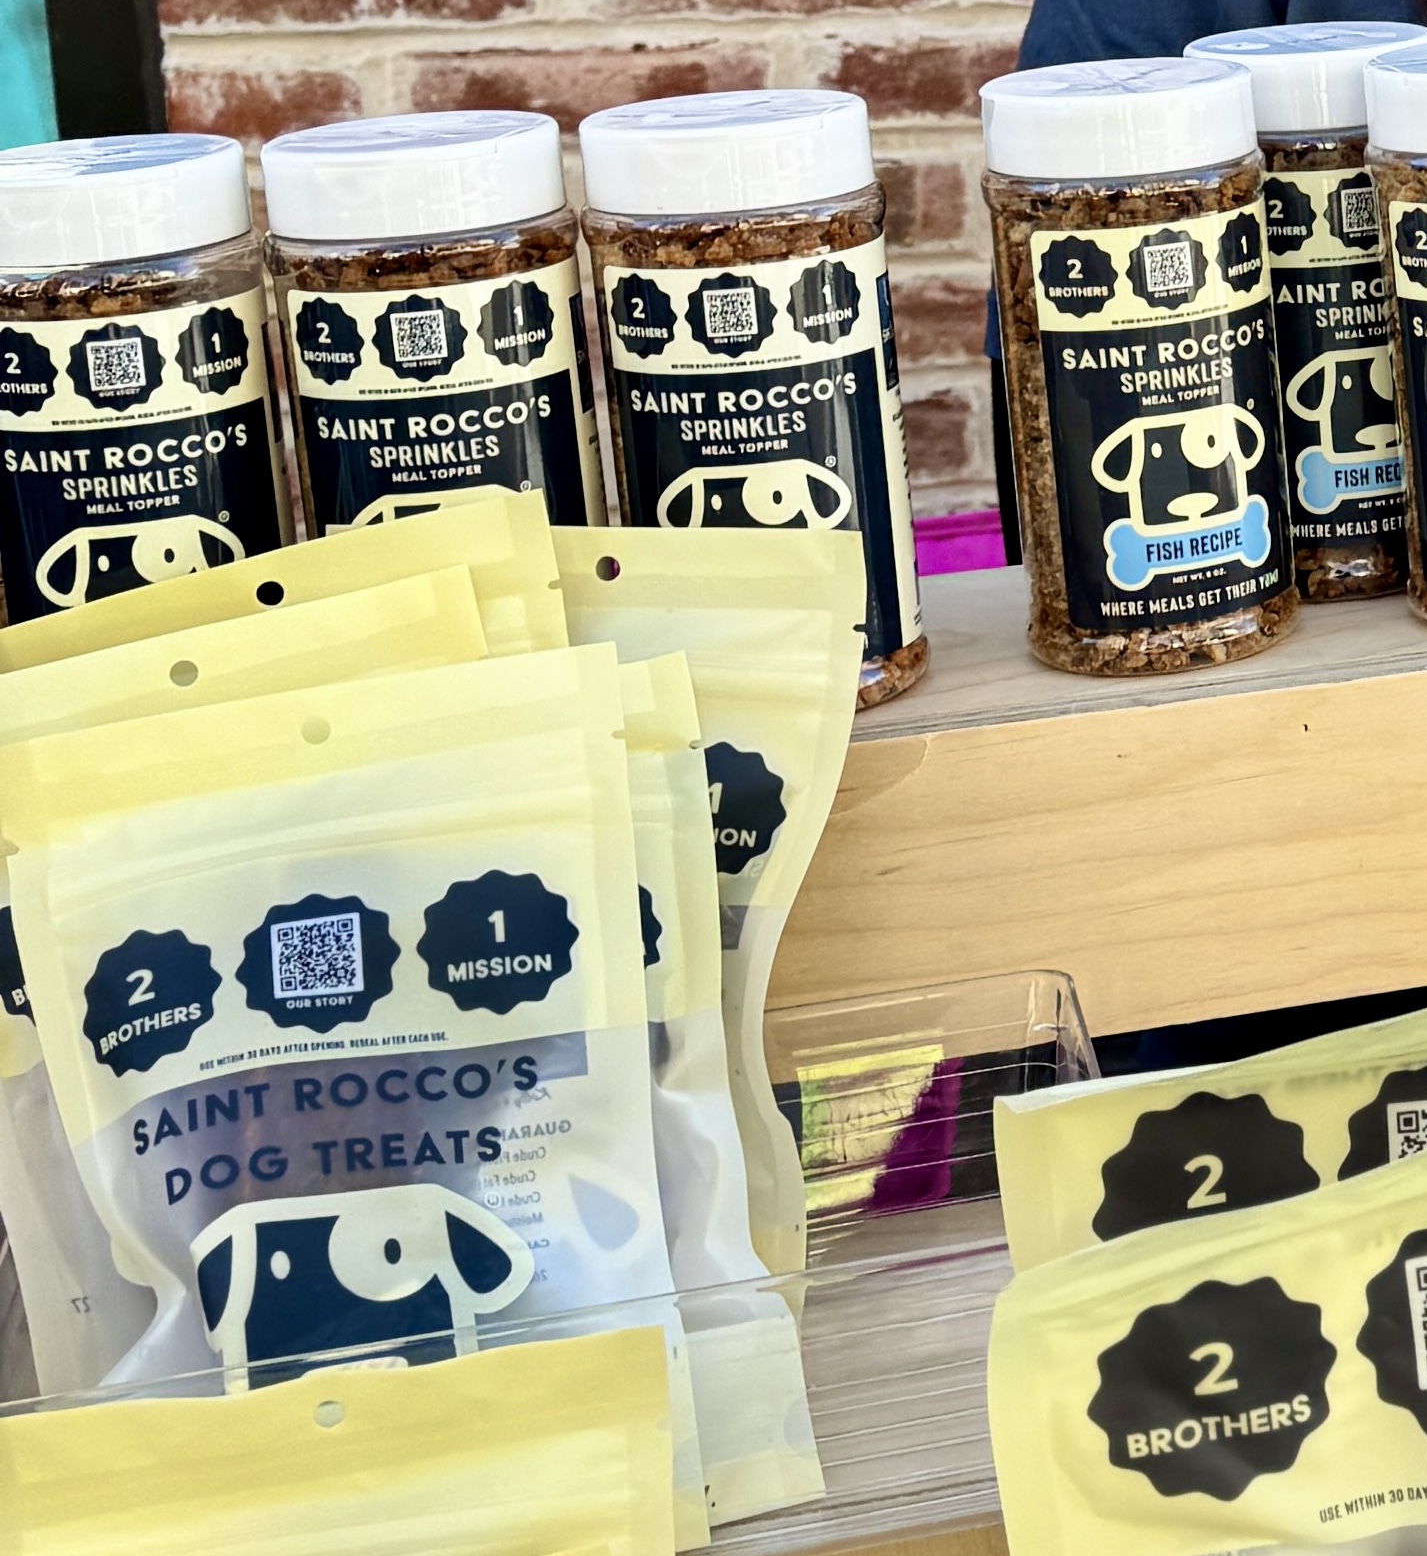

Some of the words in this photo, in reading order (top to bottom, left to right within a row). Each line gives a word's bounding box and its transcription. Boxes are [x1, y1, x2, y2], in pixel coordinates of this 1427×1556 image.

[1067, 259, 1083, 278] 2
[1049, 286, 1108, 297] BROTHERS
[803, 307, 852, 328] MISSION
[1062, 345, 1146, 370] SAINT
[1158, 316, 1264, 363] ROCCO'S
[631, 389, 706, 413] SAINT
[718, 372, 856, 412] ROCCO'S
[1120, 358, 1233, 394] SPRINKLES
[681, 411, 806, 441] SPRINKLES
[4, 449, 90, 472] SAINT
[104, 423, 247, 469] ROCCO'S
[702, 445, 735, 455] MEAL
[746, 439, 788, 452] TOPPER
[62, 465, 198, 500] SPRINKLES
[1146, 540, 1184, 563] FISH
[1190, 527, 1242, 556] RECIPE
[488, 910, 505, 943] 1
[447, 954, 552, 982] MISSION
[126, 969, 155, 1006] 2
[286, 999, 311, 1009] OUR
[316, 996, 352, 1007] STORY
[100, 1003, 201, 1054] BROTHERS
[133, 1083, 271, 1156] SAINT
[293, 1056, 539, 1111] ROCCO'S
[165, 1146, 288, 1206] DOG
[312, 1126, 503, 1176] TREATS
[1189, 1342, 1238, 1396] 2
[1126, 1394, 1311, 1458] BROTHERS
[1319, 1505, 1342, 1523] USE
[1344, 1492, 1385, 1515] WITHIN
[1389, 1489, 1404, 1503] 30
